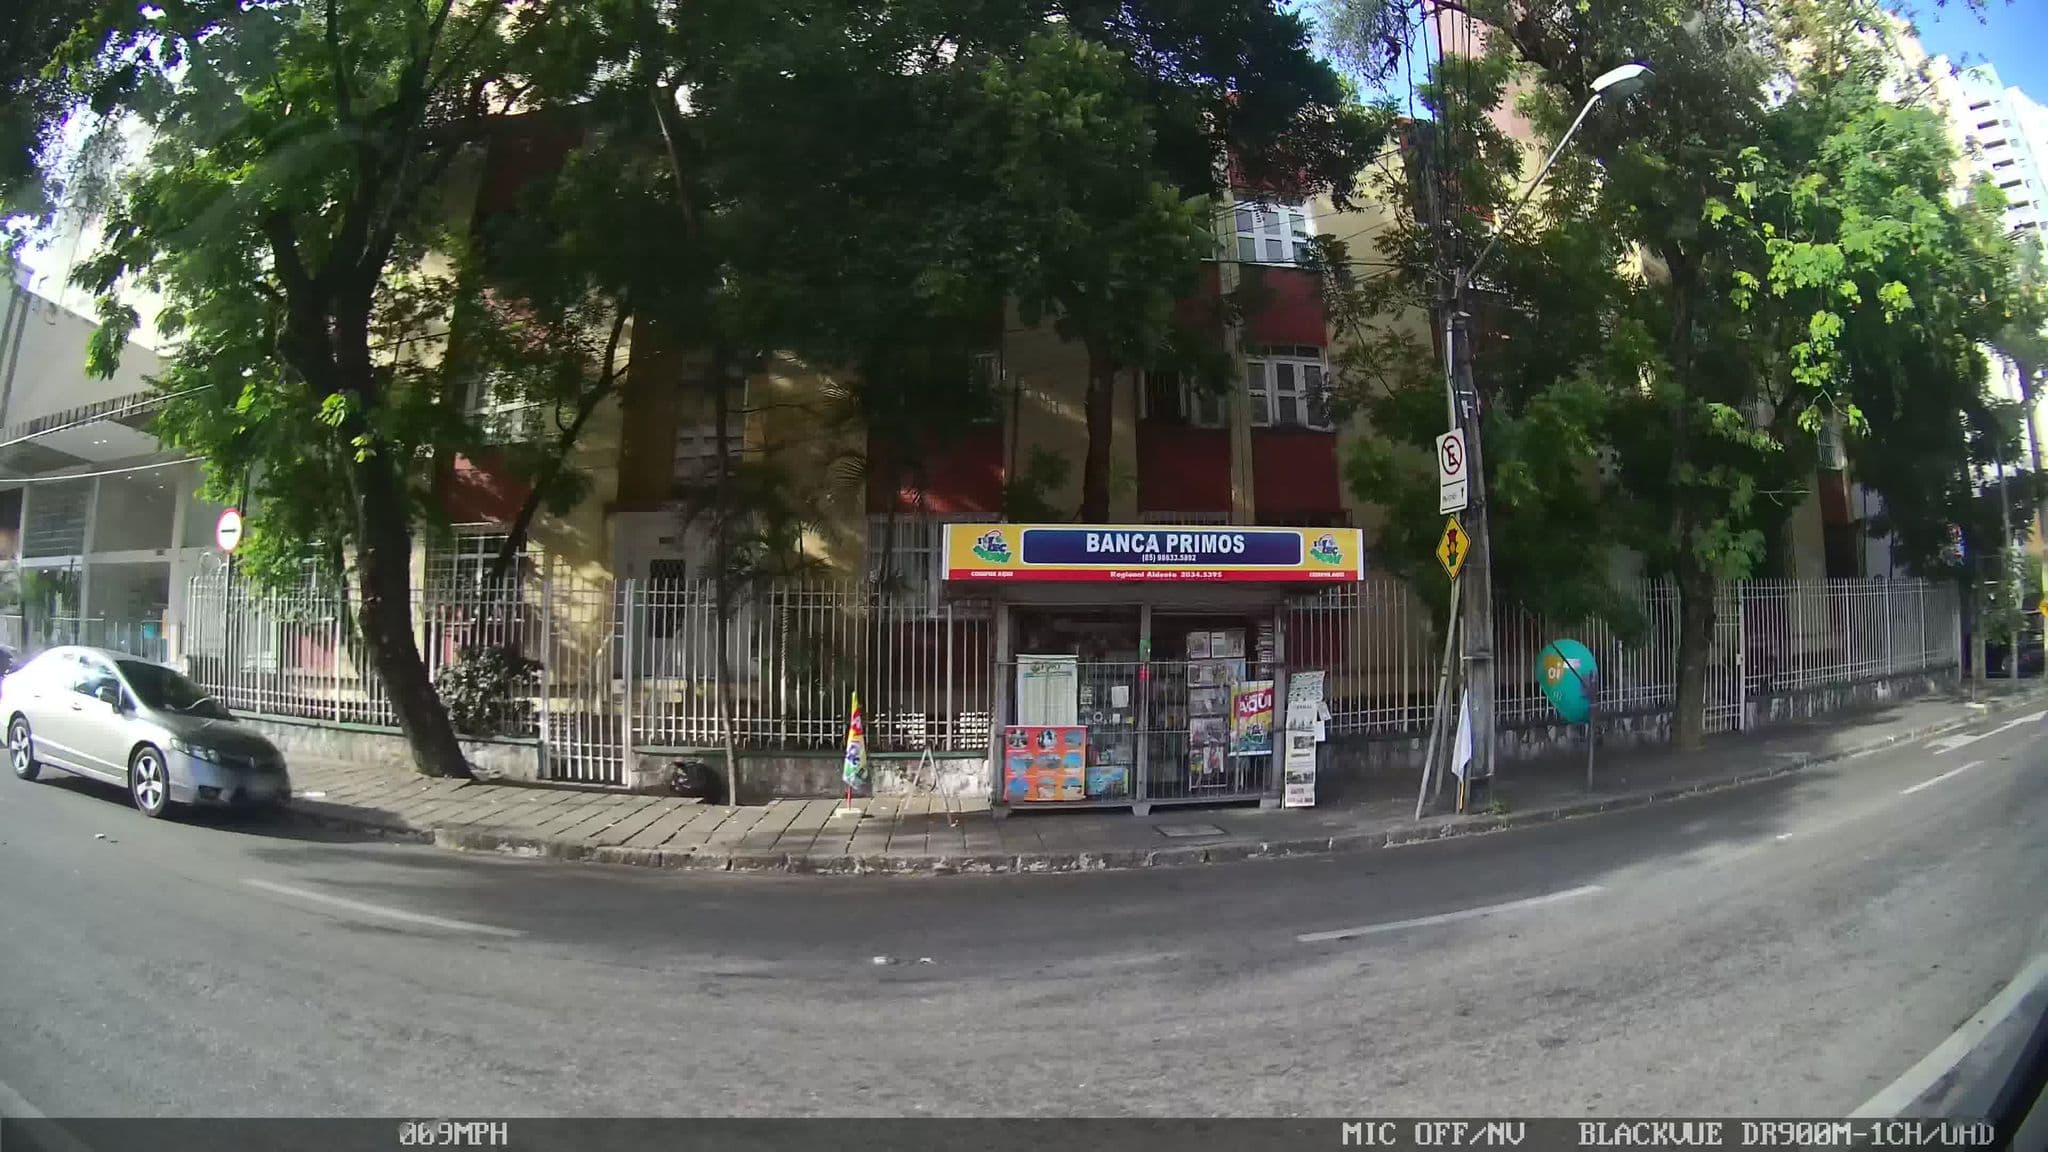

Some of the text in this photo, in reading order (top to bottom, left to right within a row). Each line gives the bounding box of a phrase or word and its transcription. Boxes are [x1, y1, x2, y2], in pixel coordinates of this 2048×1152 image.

[1086, 533, 1245, 554] BANCA PRIMOS
[1239, 693, 1272, 713] AQUI
